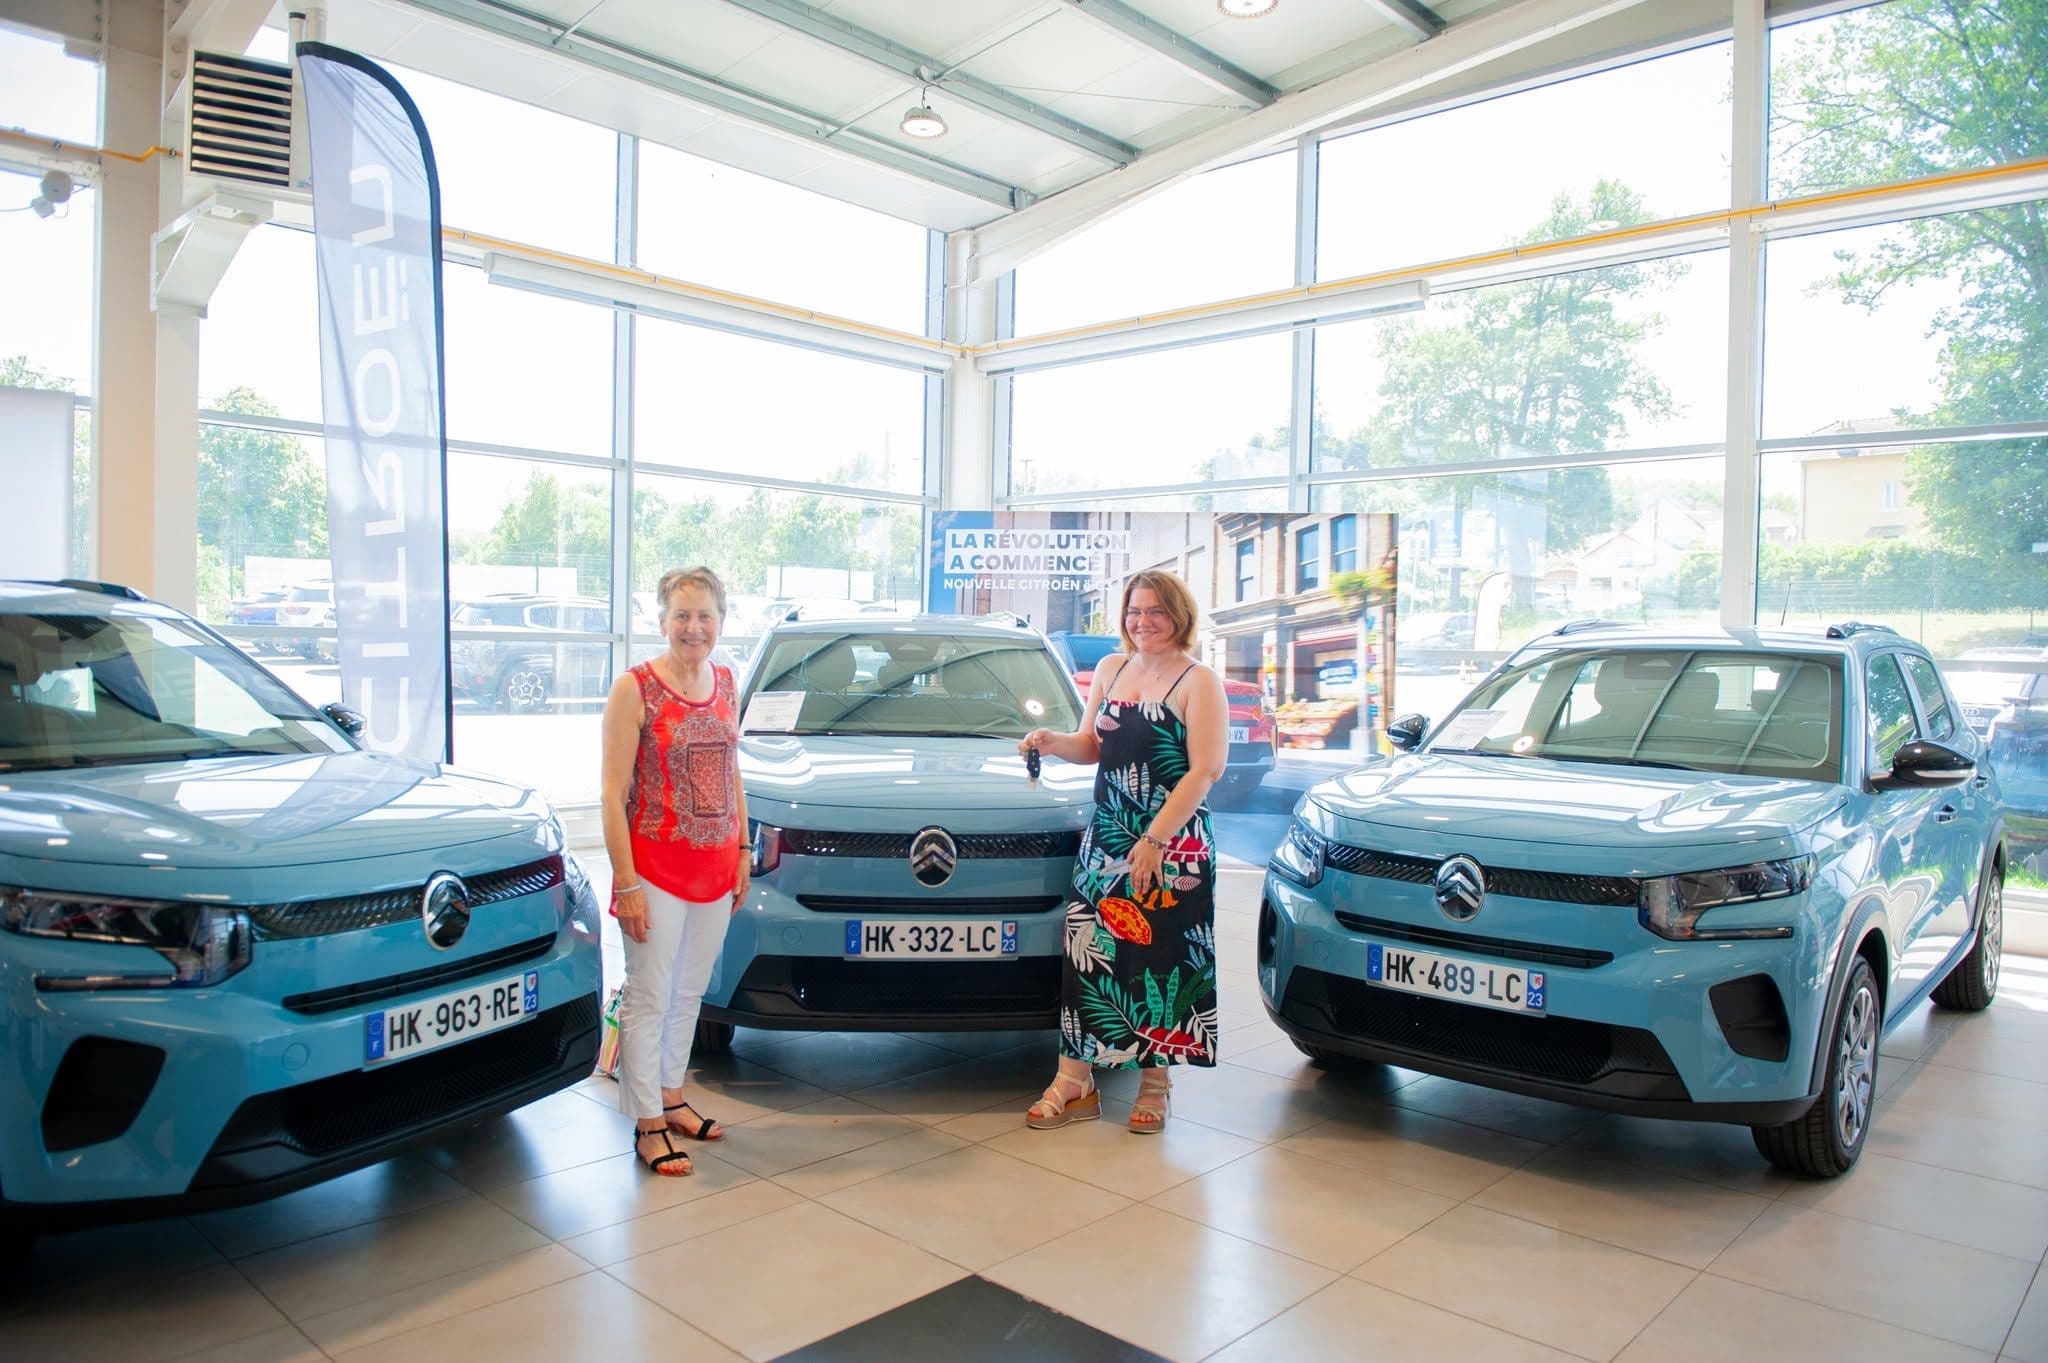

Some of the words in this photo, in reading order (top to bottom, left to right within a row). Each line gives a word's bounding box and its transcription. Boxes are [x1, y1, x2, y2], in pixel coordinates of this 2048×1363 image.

[951, 533, 978, 549] LA
[984, 529, 1126, 550] RÉVOLUTION
[950, 554, 964, 570] A
[970, 551, 1101, 571] COMMENCÉ
[944, 578, 1015, 591] NOUVELLE
[1019, 576, 1080, 591] CITROËN
[865, 926, 996, 953] HK-332-LC
[1002, 939, 1016, 952] 23
[1386, 952, 1521, 1003] HK-489-LC
[1528, 992, 1543, 1007] 23
[372, 1040, 380, 1052] F
[389, 982, 520, 1051] HK-963-RE
[525, 994, 538, 1010] 23
